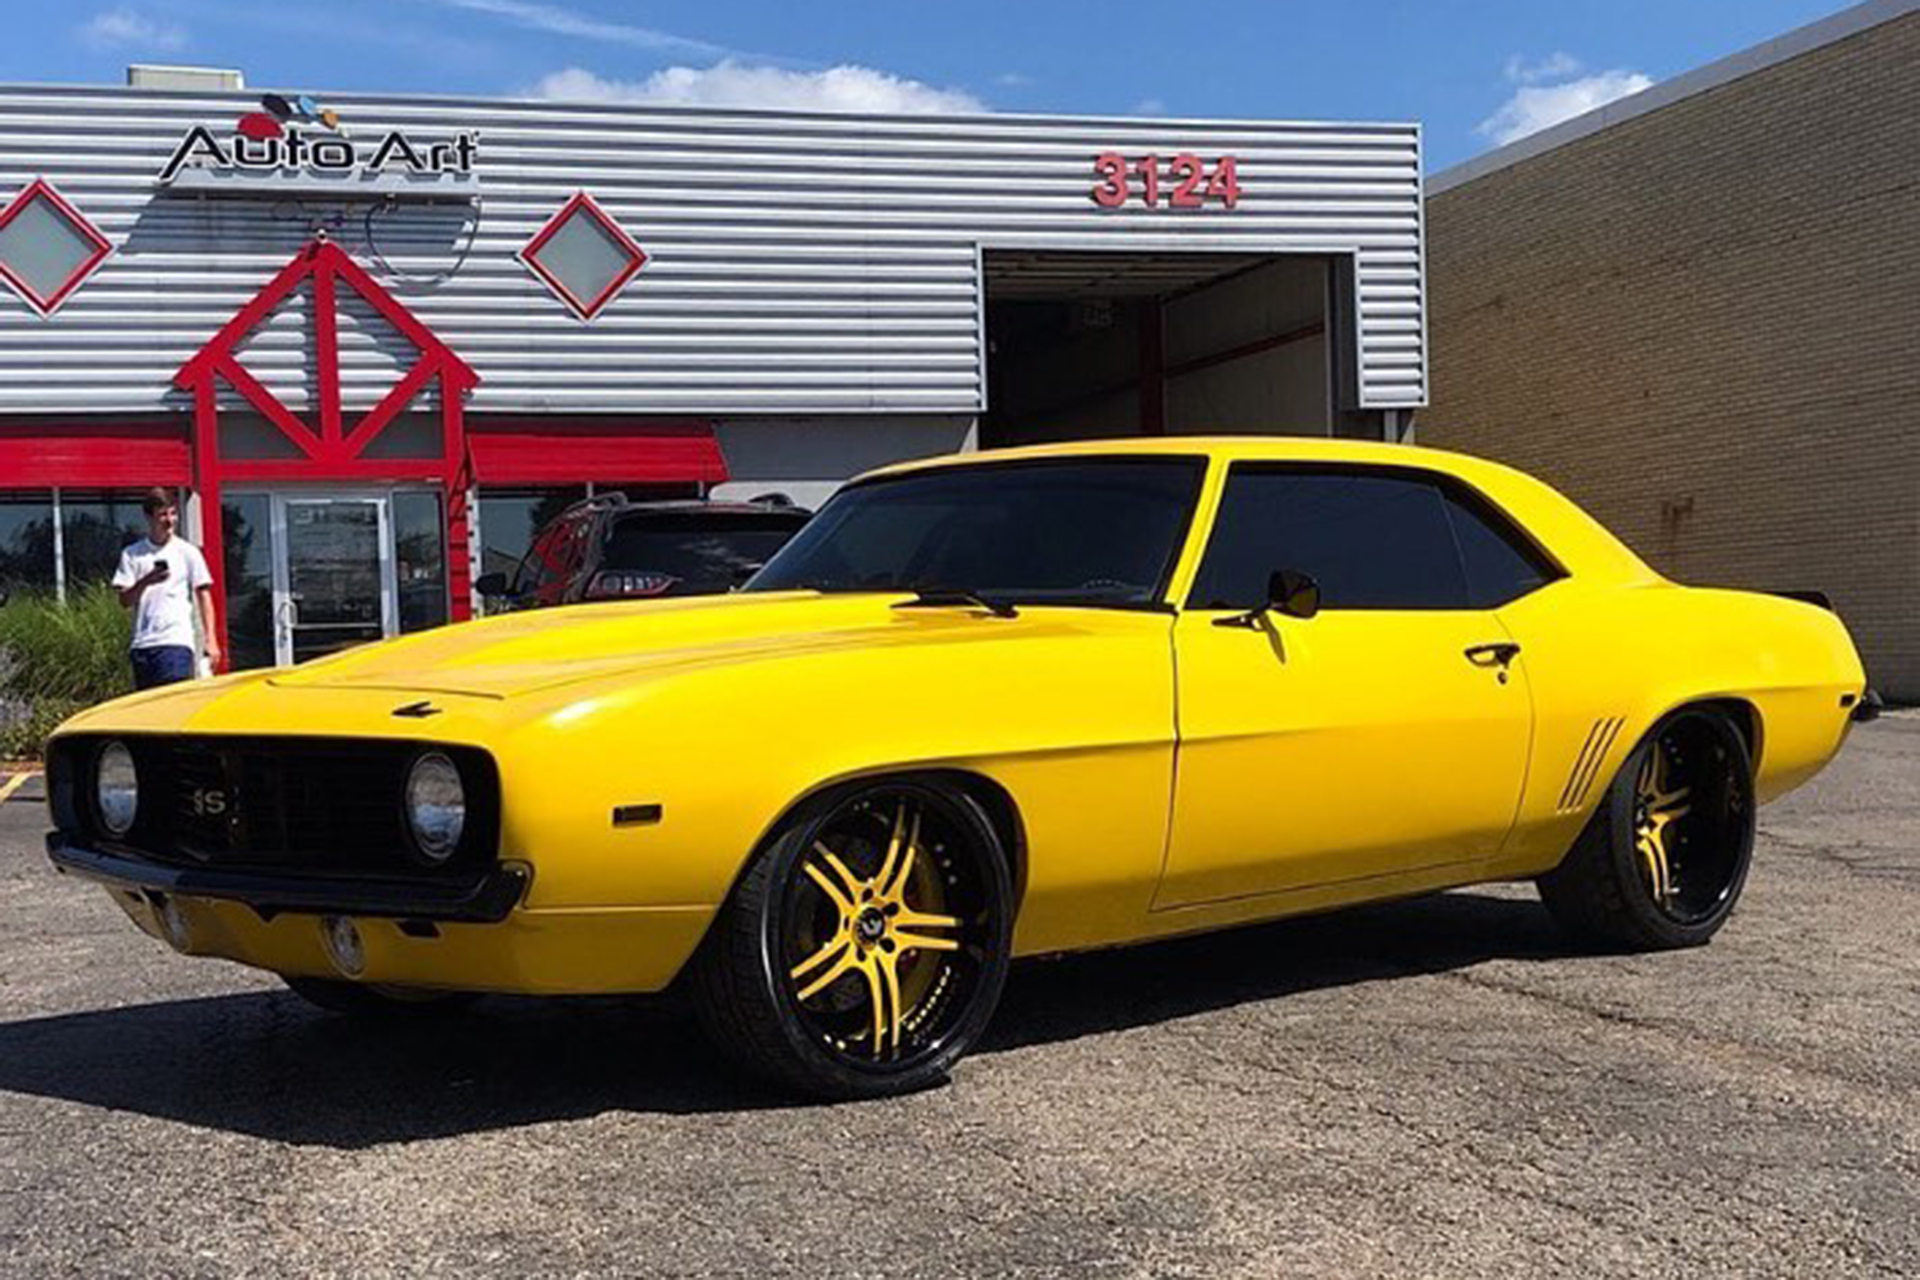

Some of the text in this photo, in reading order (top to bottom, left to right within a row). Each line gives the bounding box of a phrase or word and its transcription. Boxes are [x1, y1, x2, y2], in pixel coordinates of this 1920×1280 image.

[158, 125, 476, 183] Auto Art
[1093, 151, 1241, 208] 3124
